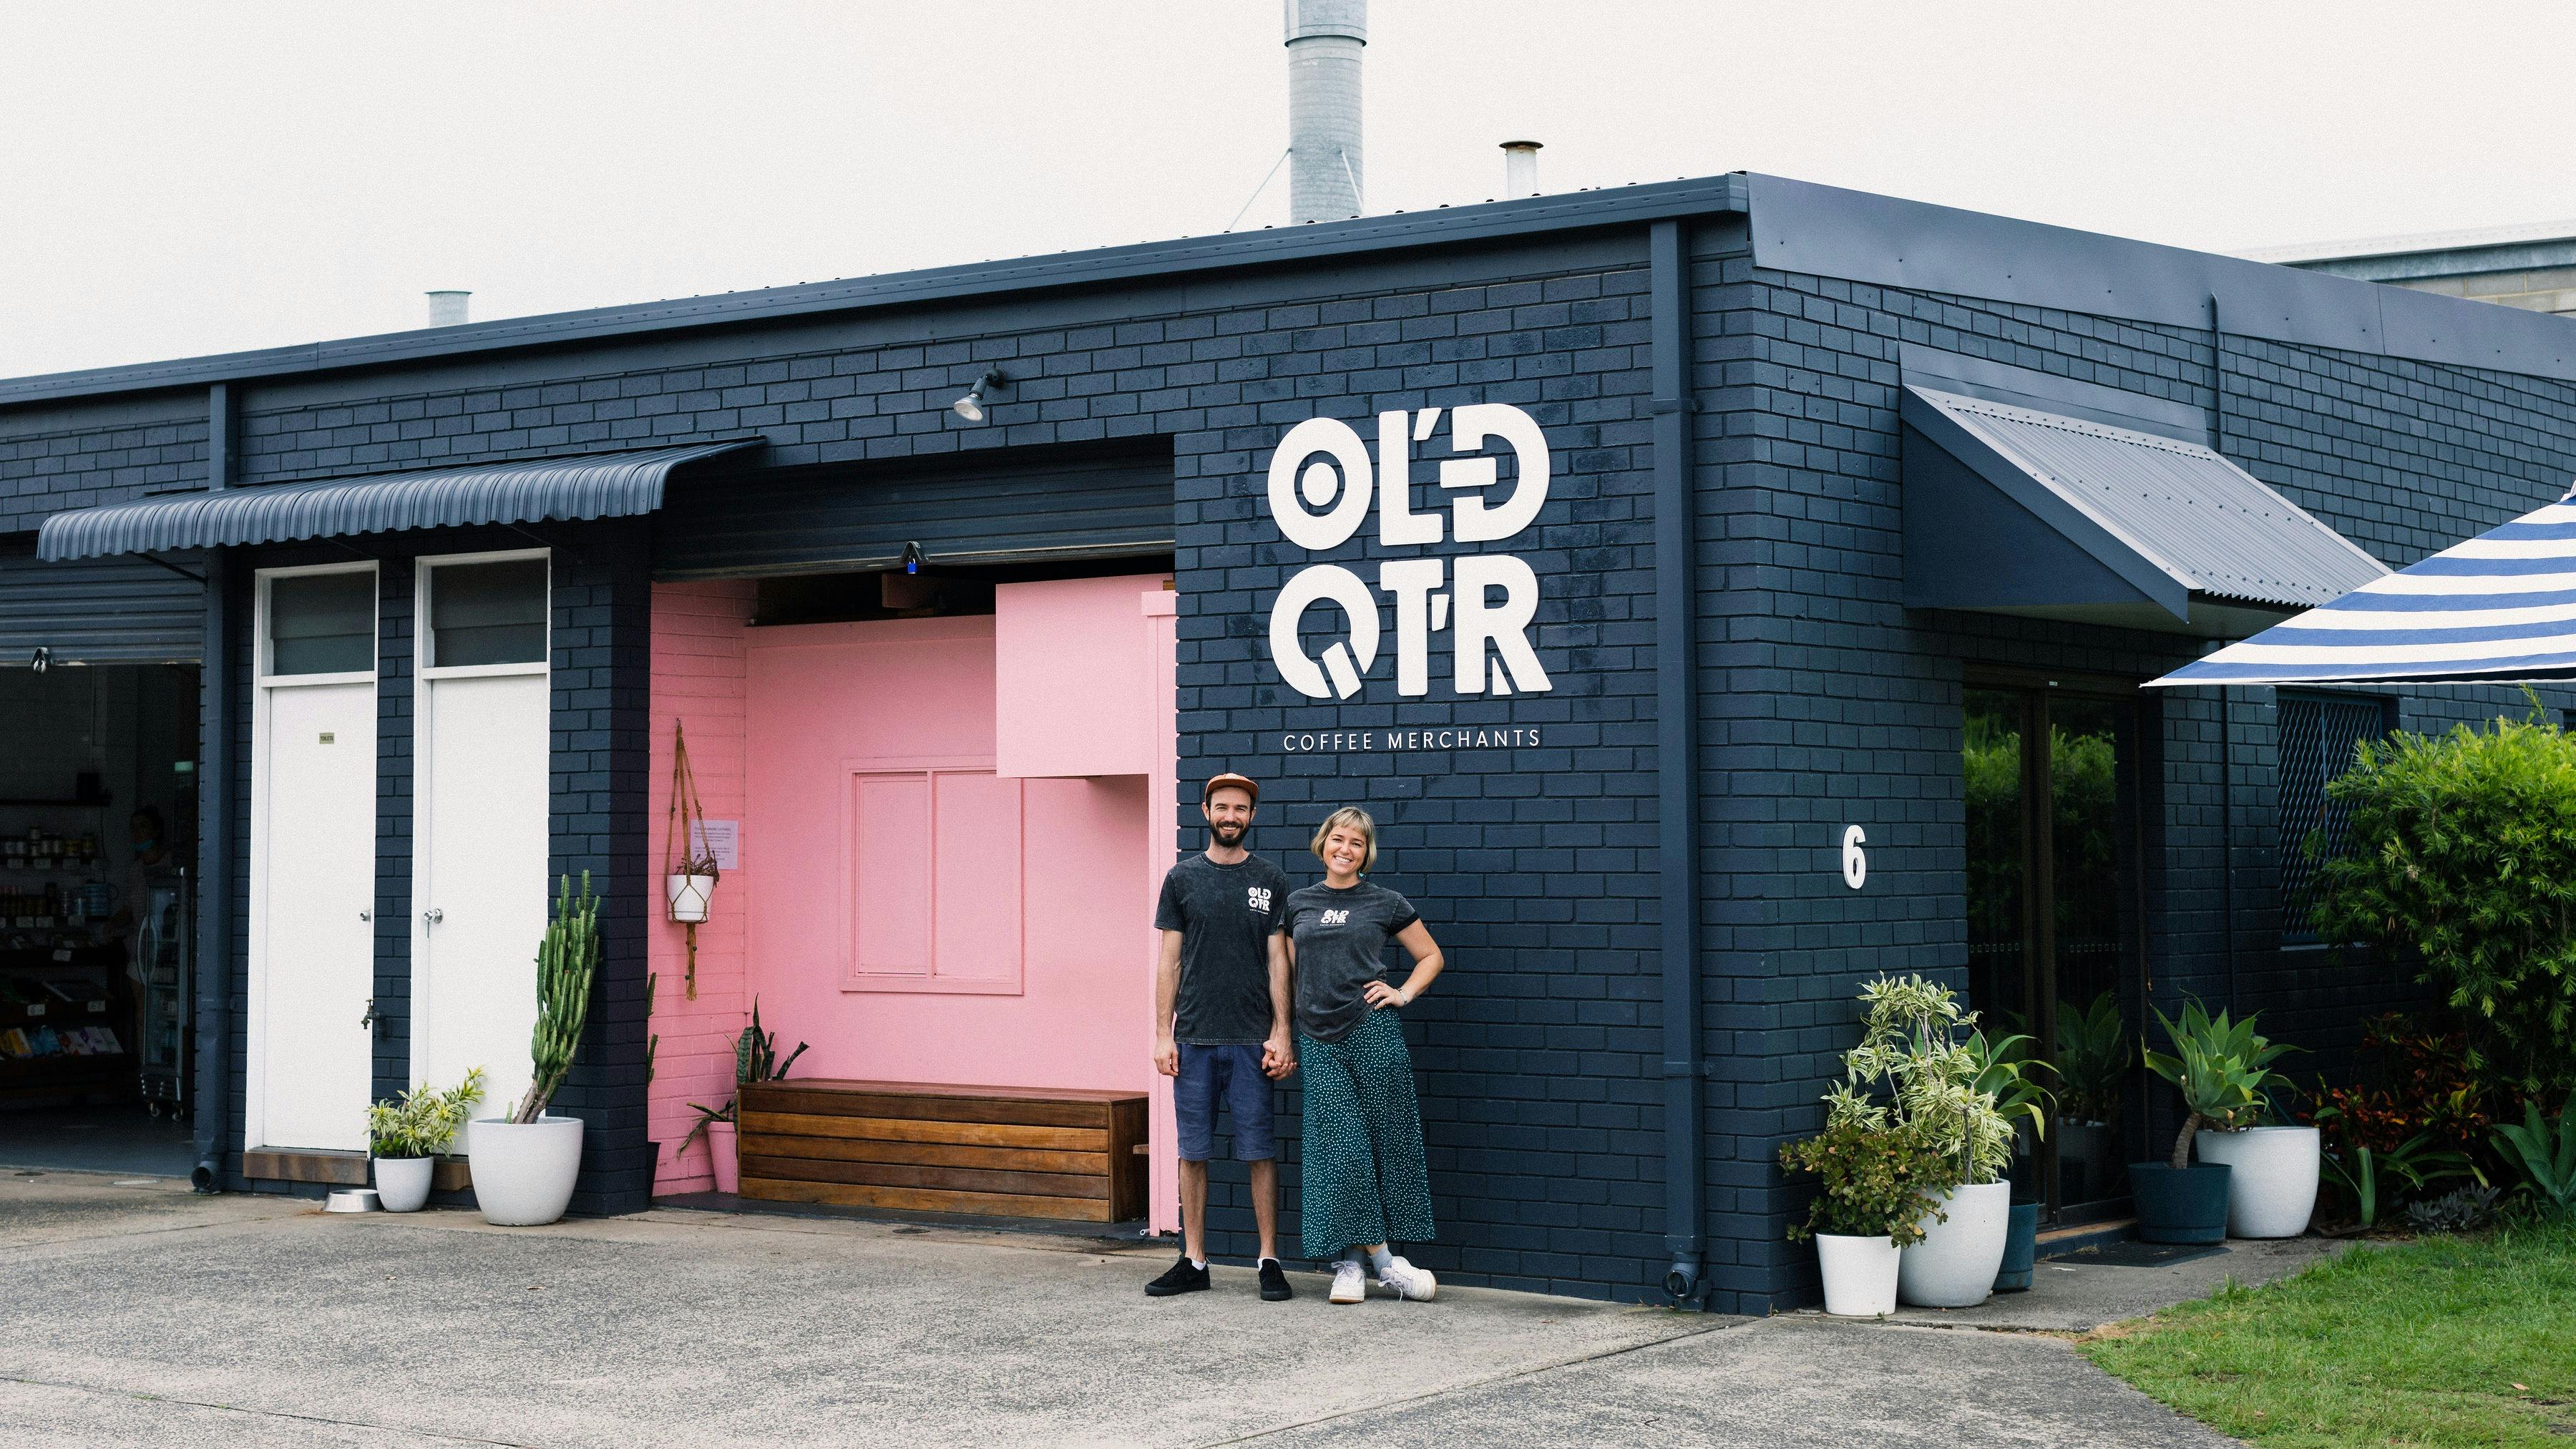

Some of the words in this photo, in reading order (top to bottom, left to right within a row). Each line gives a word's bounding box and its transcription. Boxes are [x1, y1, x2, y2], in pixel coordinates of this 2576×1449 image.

[1284, 733, 1372, 751] COFFEE
[1389, 729, 1540, 749] MERCHANTS
[1843, 825, 1865, 889] 6
[1248, 887, 1272, 899] OLD
[1249, 897, 1270, 911] QTR
